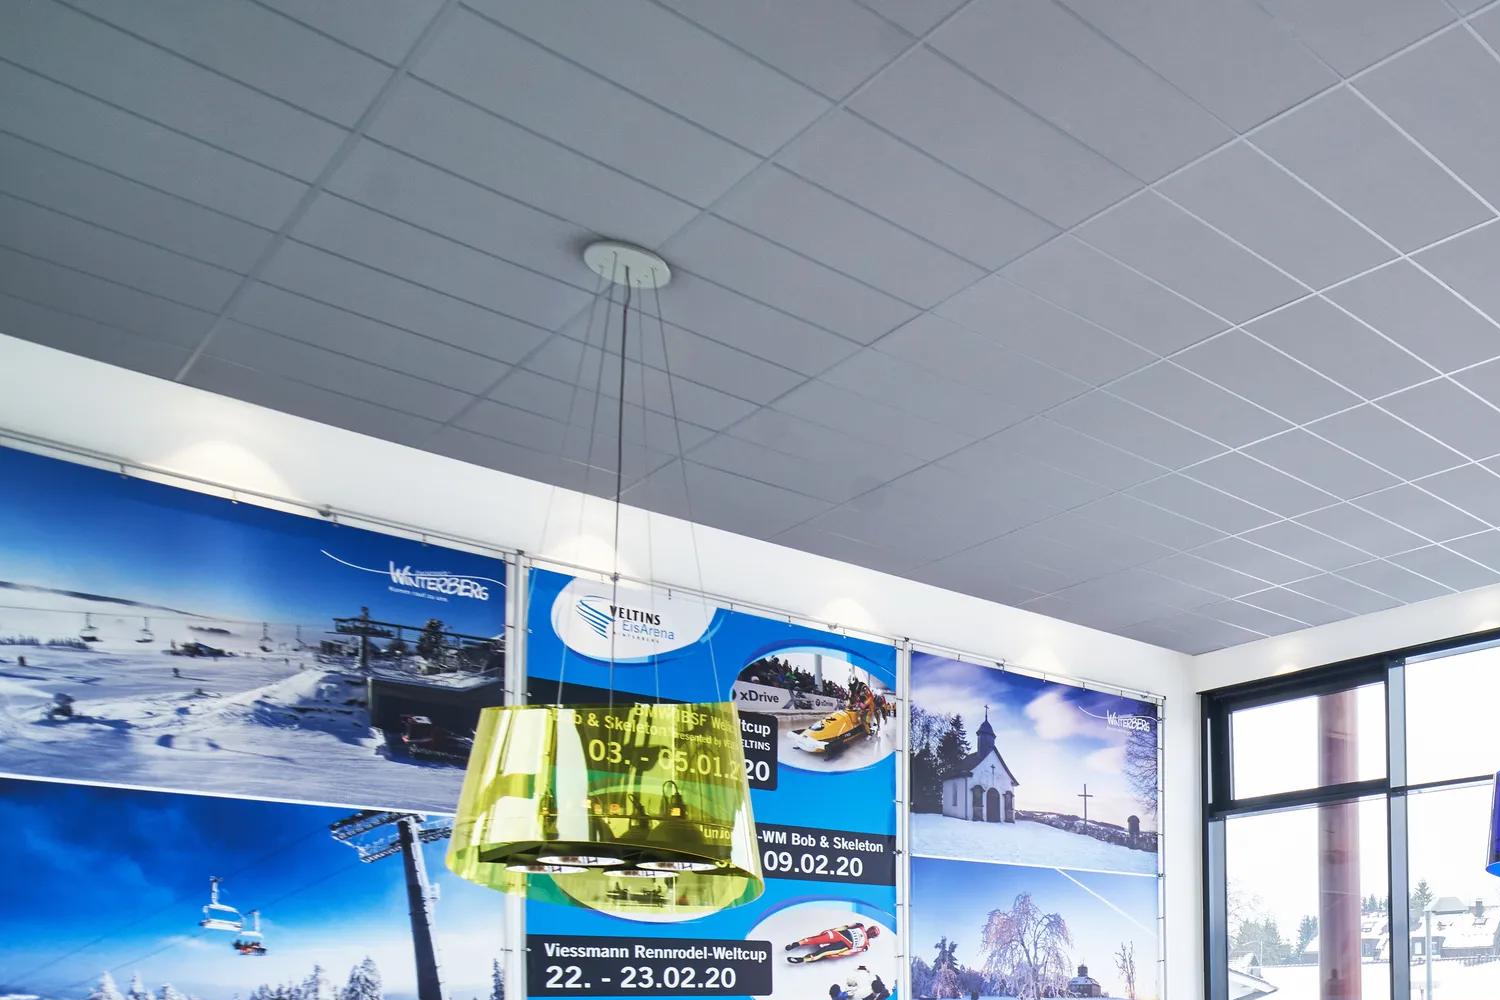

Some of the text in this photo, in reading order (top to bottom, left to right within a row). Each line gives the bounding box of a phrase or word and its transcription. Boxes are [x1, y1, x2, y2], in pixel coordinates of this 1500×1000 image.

[609, 605, 661, 626] VELTINS
[622, 620, 675, 640] EisArena
[739, 690, 779, 704] xDrive
[587, 712, 600, 728] &
[604, 715, 669, 737] Skeleton
[588, 739, 630, 765] 03.
[791, 832, 817, 847] Bob
[819, 835, 830, 849] &
[833, 836, 884, 853] Skeleton
[763, 850, 864, 877] 09.02.20
[544, 942, 768, 963] Viessmann Rennrodel-Weltcup
[545, 965, 592, 989] 22.
[620, 965, 737, 989] 23.02.20
